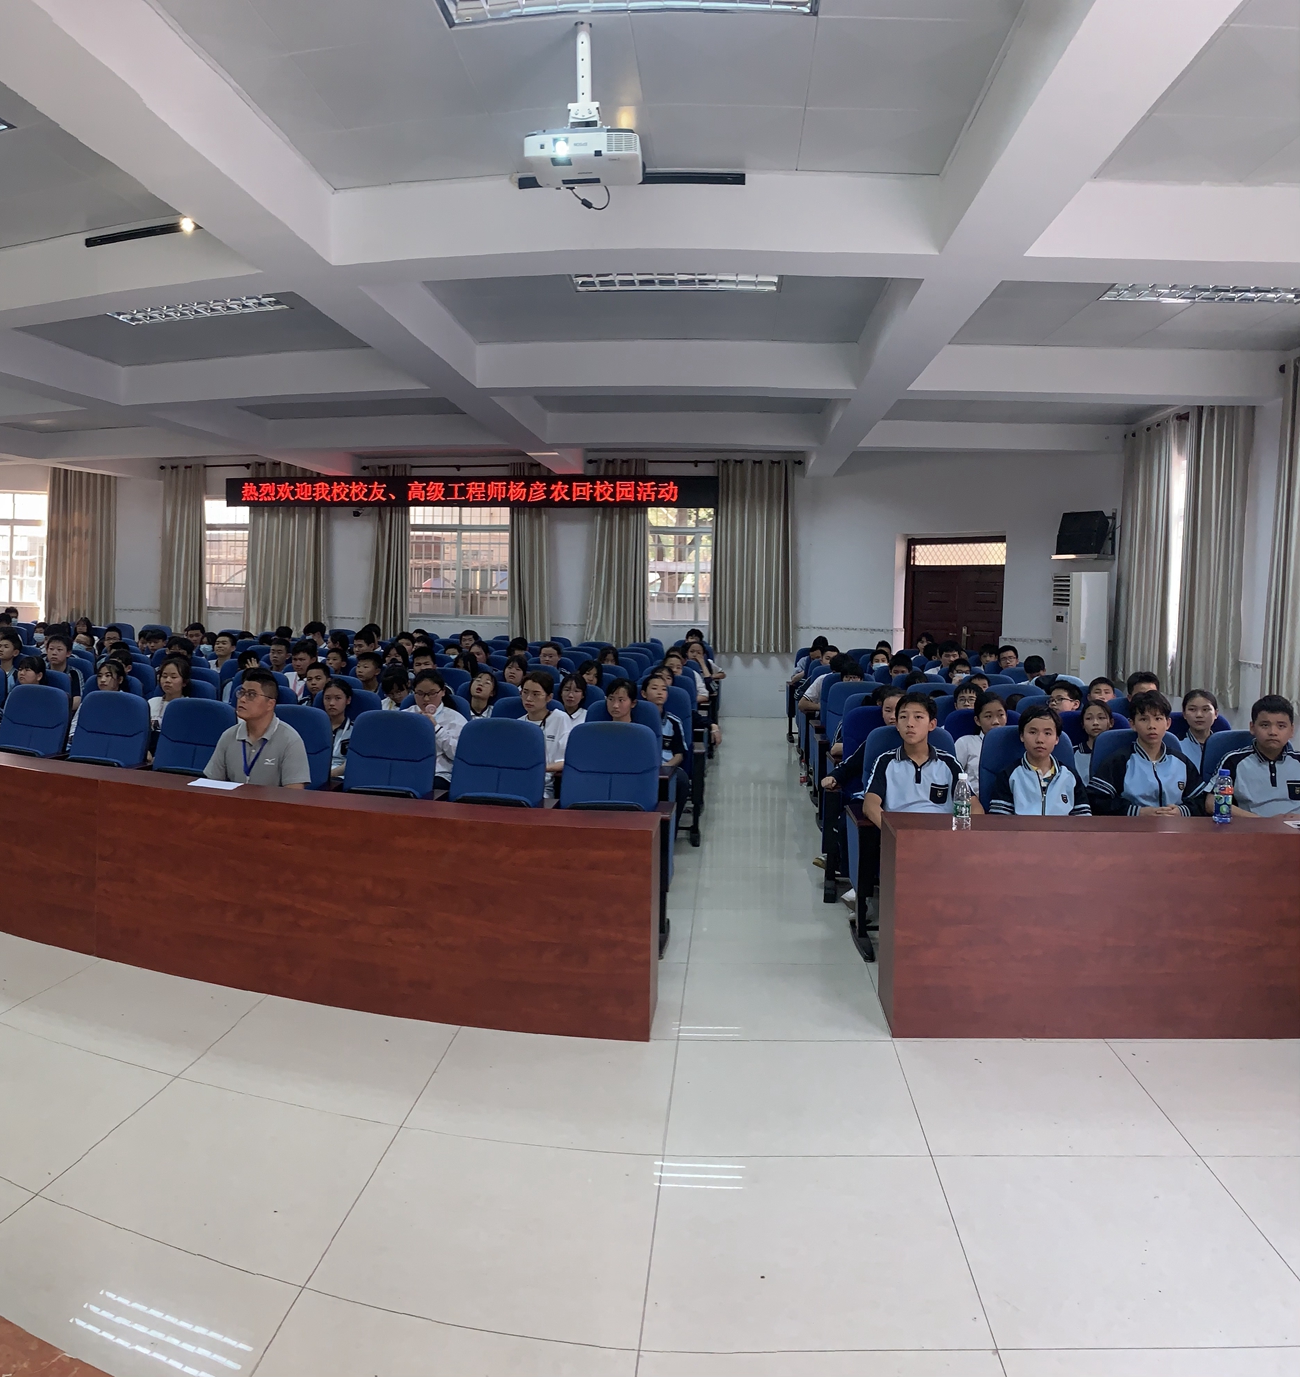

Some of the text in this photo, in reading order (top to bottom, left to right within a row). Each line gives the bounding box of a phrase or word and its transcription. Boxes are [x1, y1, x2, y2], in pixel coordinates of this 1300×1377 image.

[241, 480, 679, 502] 热烈欢迎我校校友、高级工程师杨彦农回校园活动
